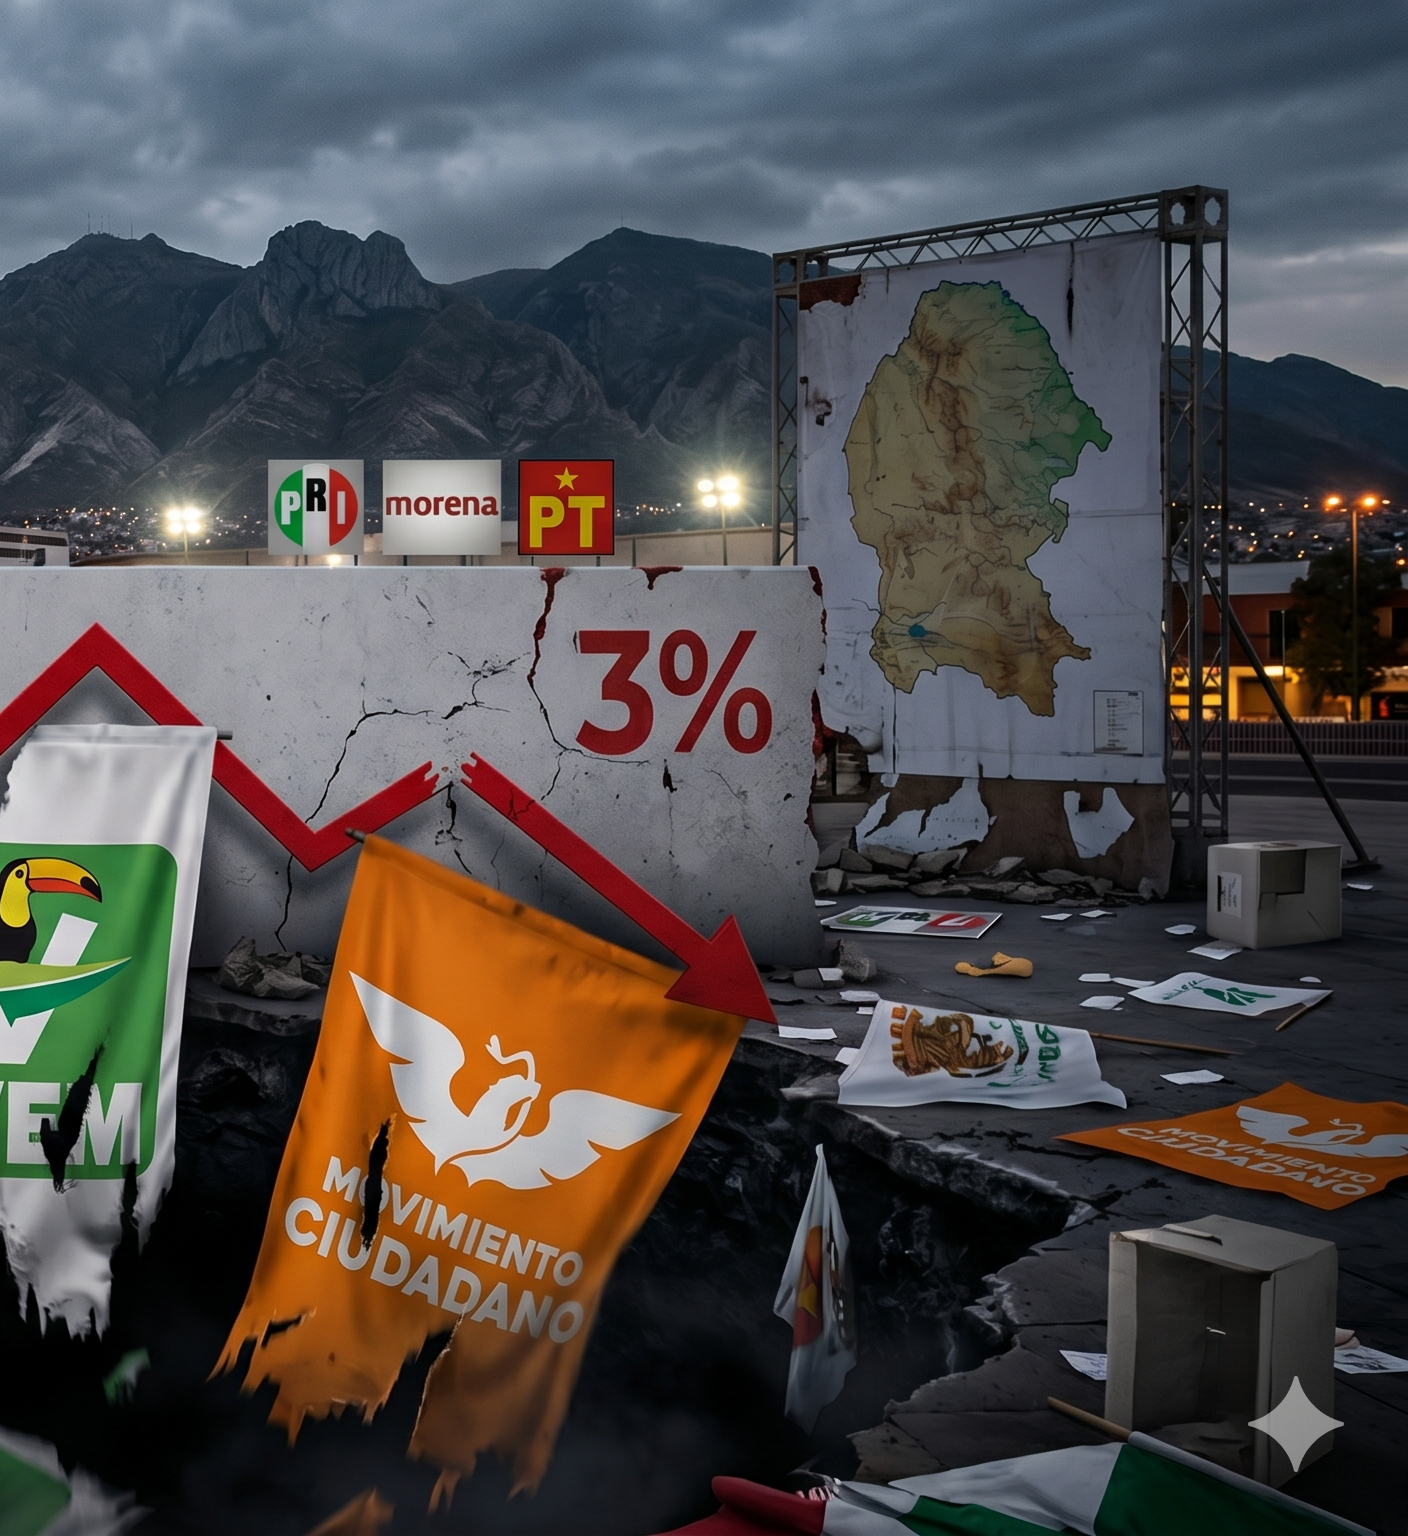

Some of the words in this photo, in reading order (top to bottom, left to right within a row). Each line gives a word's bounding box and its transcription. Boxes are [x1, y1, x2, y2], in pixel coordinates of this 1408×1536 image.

[280, 477, 346, 525] PRI
[385, 496, 499, 516] morena
[529, 496, 606, 548] PT
[575, 629, 773, 755] 3%
[1117, 1128, 1367, 1196] CIUDADANO
[1159, 1128, 1377, 1183] MOVIMIENTO
[284, 1197, 585, 1344] CIUDADANO
